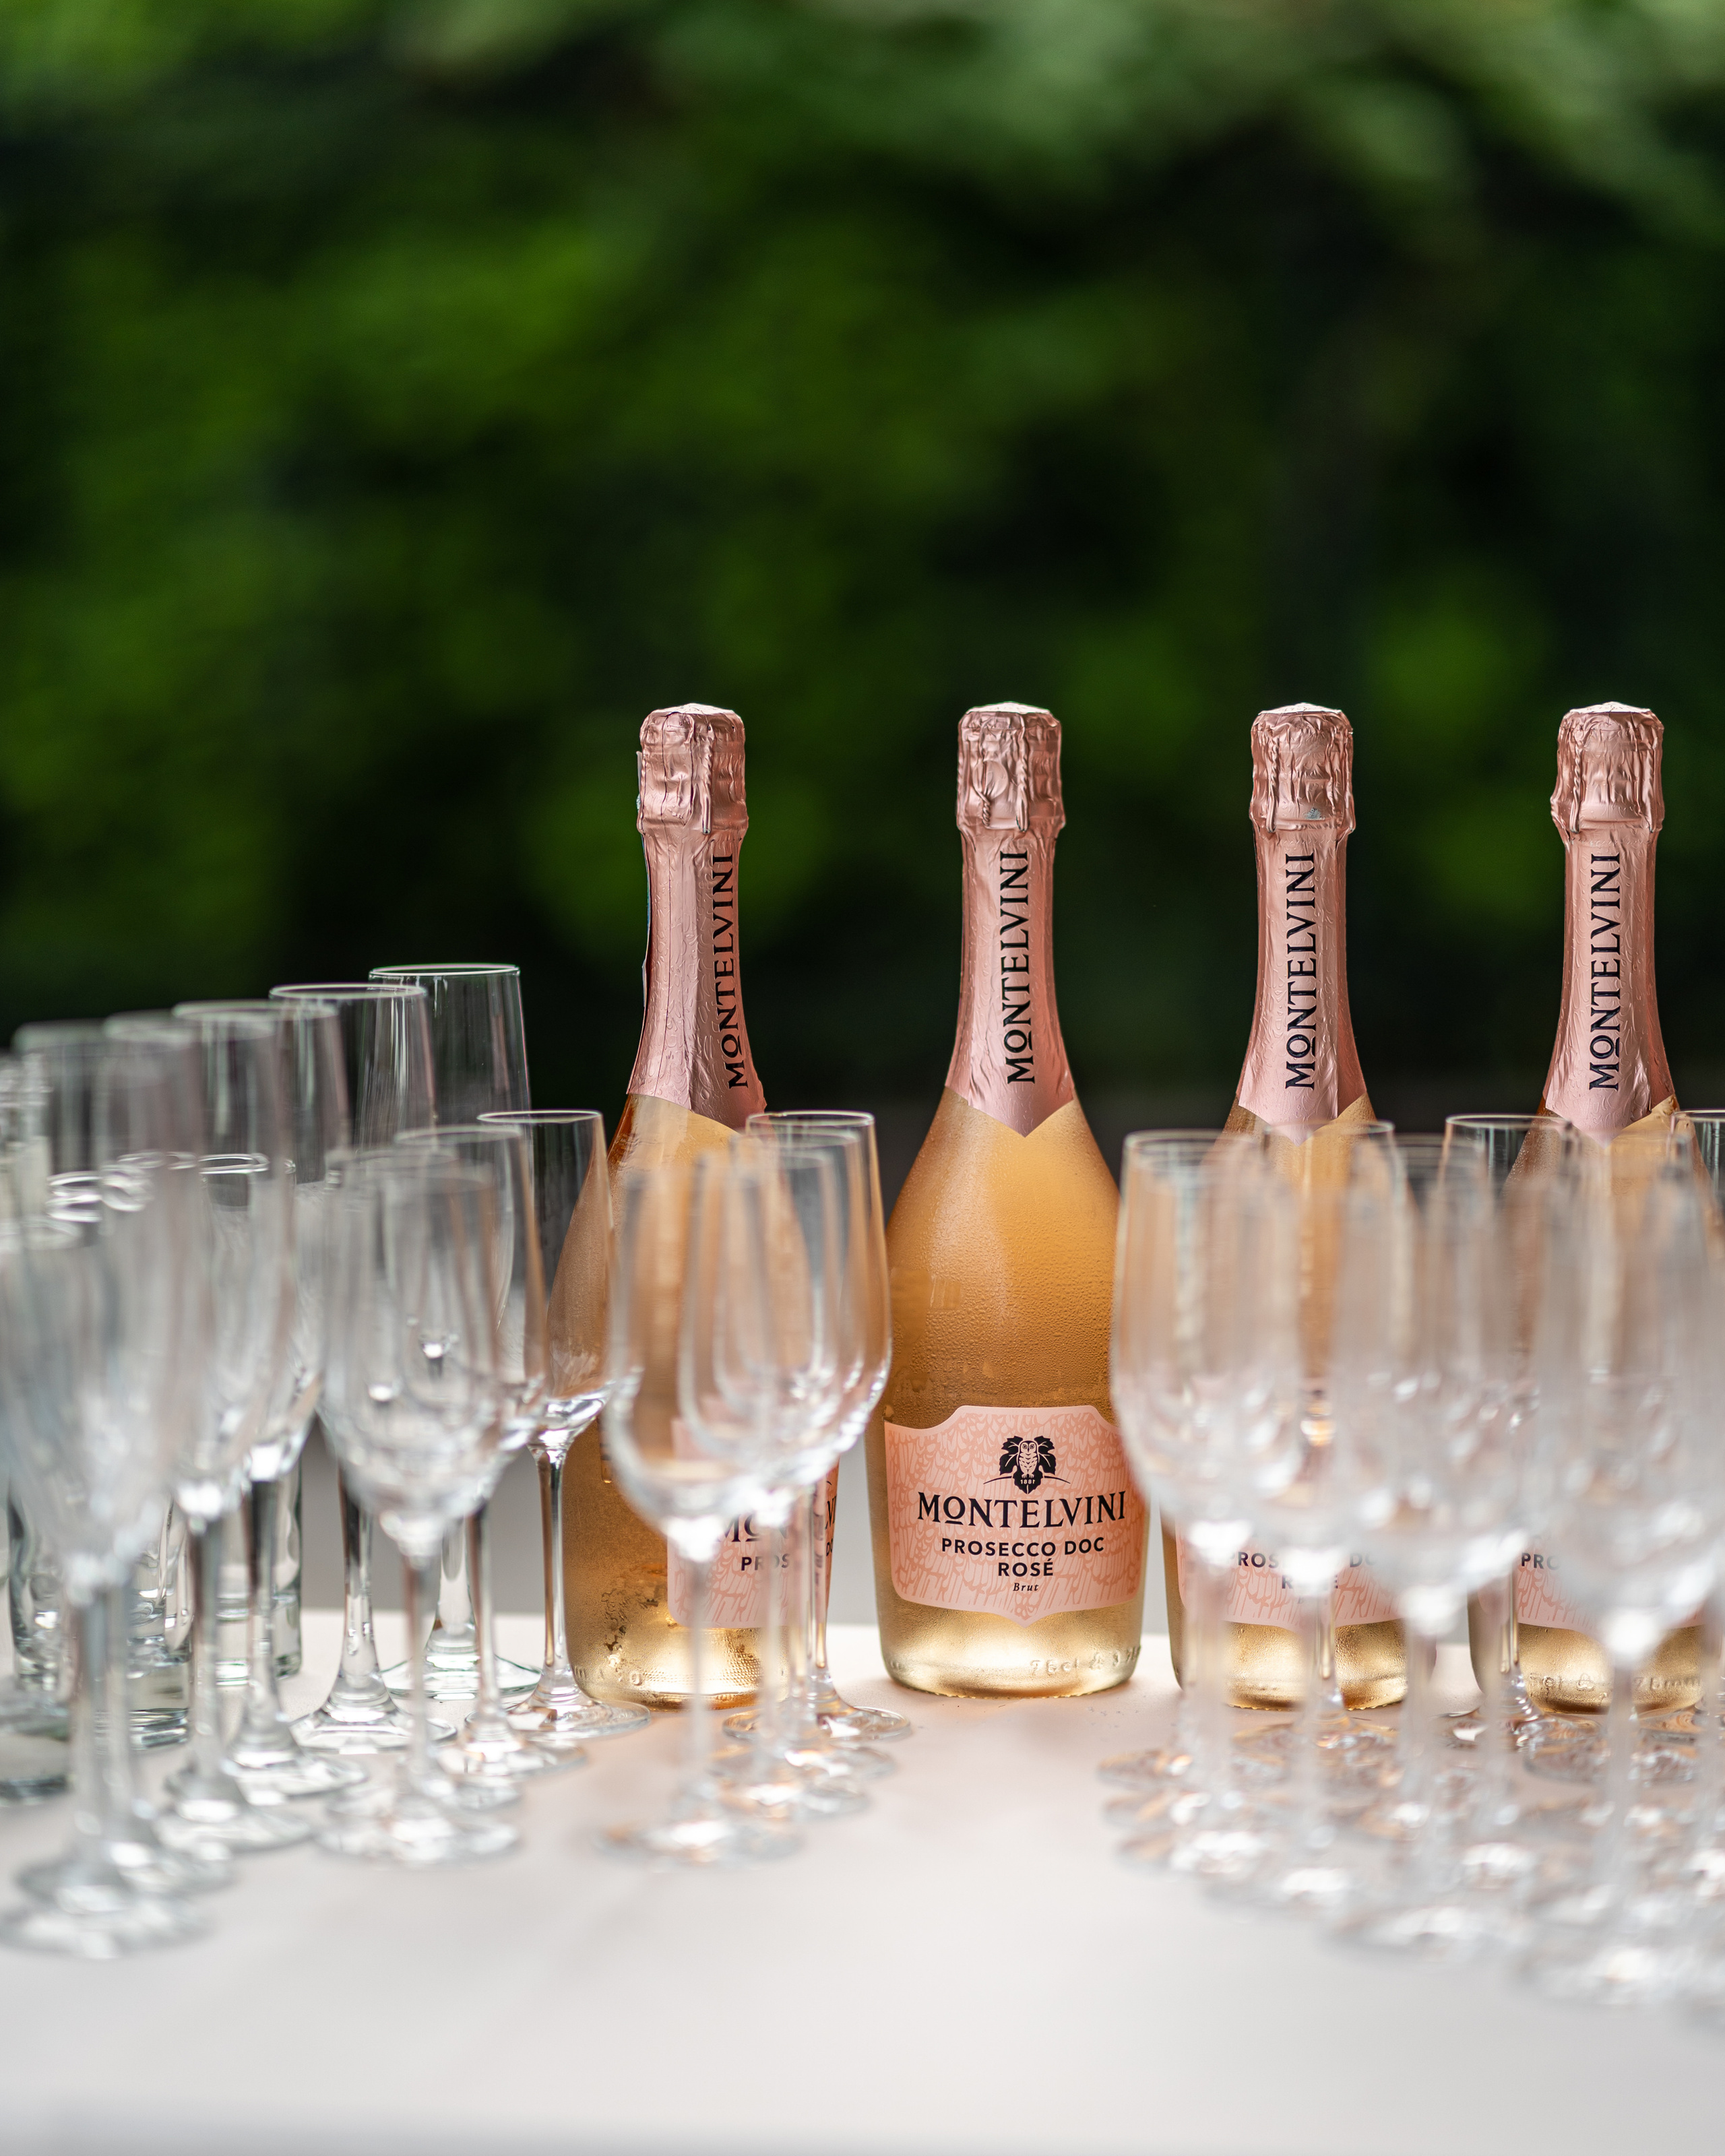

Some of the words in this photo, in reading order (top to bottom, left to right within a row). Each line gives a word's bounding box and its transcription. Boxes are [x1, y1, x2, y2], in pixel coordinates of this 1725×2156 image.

[712, 853, 748, 1089] MONTELVINI
[999, 850, 1035, 1085] MONTELVINI
[1285, 852, 1317, 1090] MONTELVINI
[1588, 852, 1621, 1091] MONTELVINI
[917, 1490, 1127, 1529] MONTELVINI
[941, 1537, 1057, 1557] PROSECCO
[1064, 1537, 1105, 1556] DOC
[997, 1558, 1054, 1577] ROSÉ
[1013, 1582, 1039, 1592] Brut
